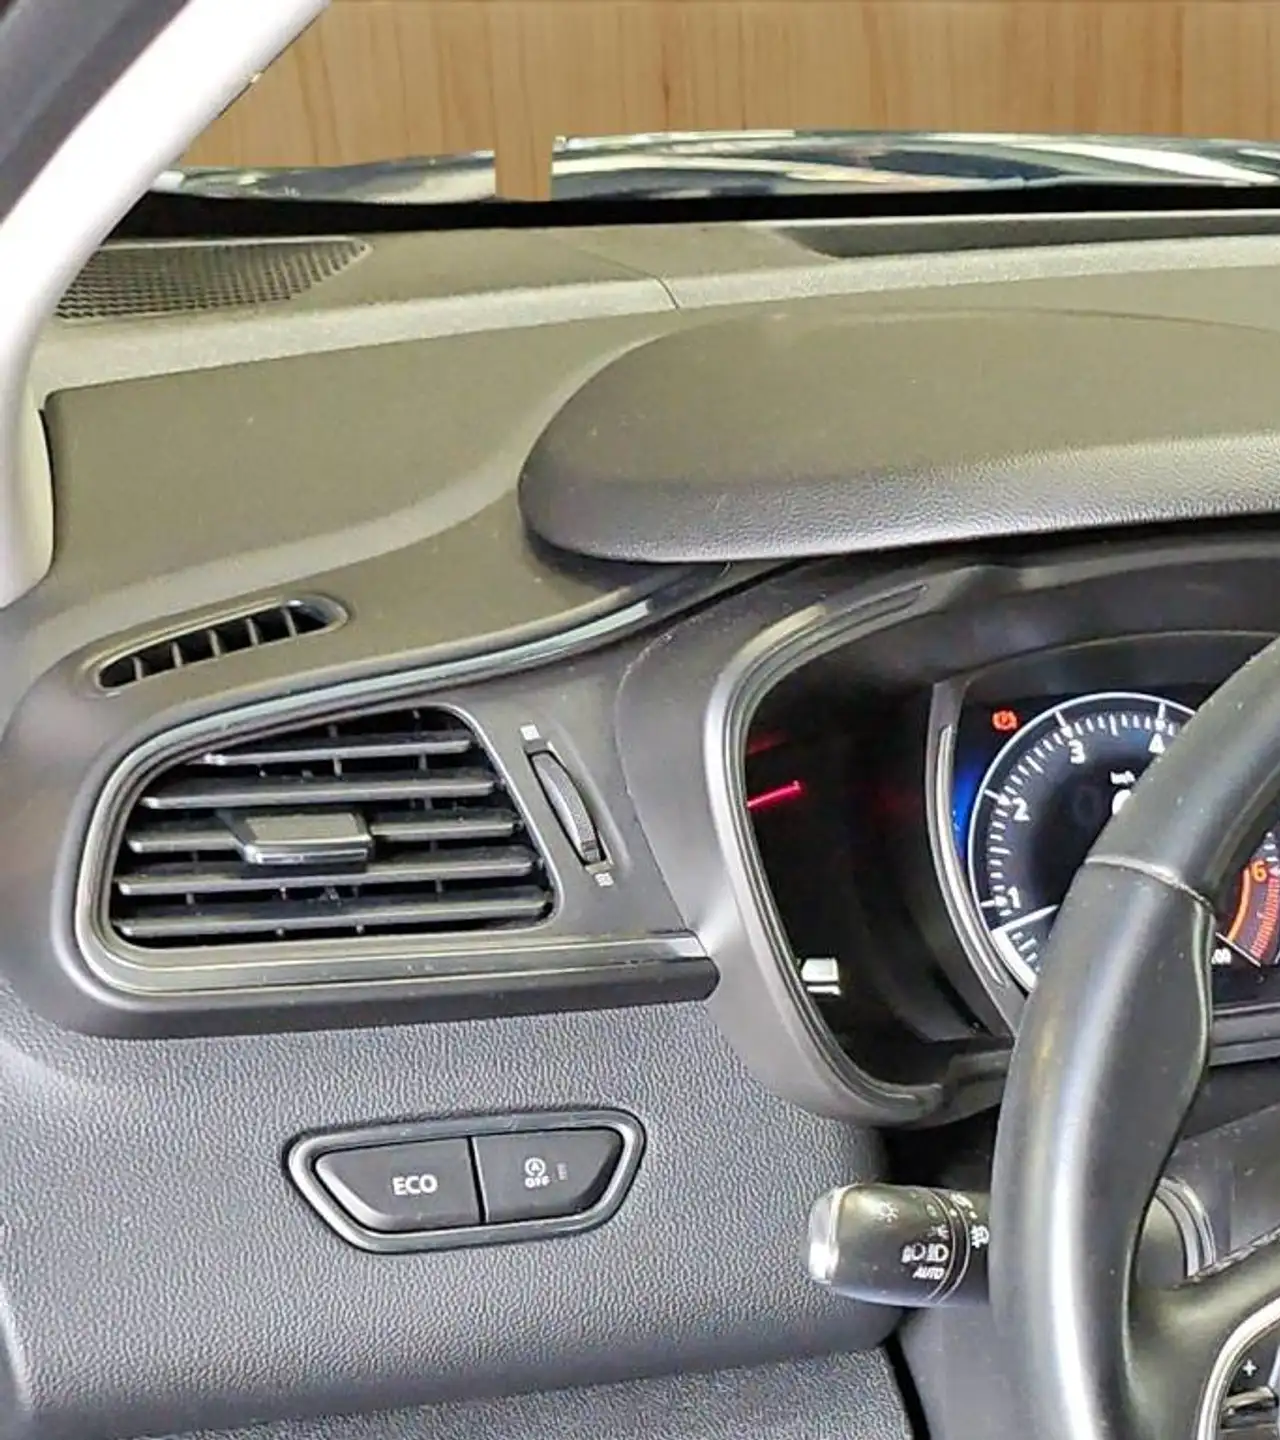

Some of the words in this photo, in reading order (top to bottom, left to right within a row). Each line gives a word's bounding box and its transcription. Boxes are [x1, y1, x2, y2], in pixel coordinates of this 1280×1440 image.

[1067, 739, 1085, 764] 3
[1148, 732, 1166, 754] 4
[1011, 797, 1030, 821] 2
[1251, 860, 1268, 882] 6
[1007, 887, 1021, 908] 1
[392, 1174, 438, 1196] ECO
[912, 1266, 946, 1280] AUTO
